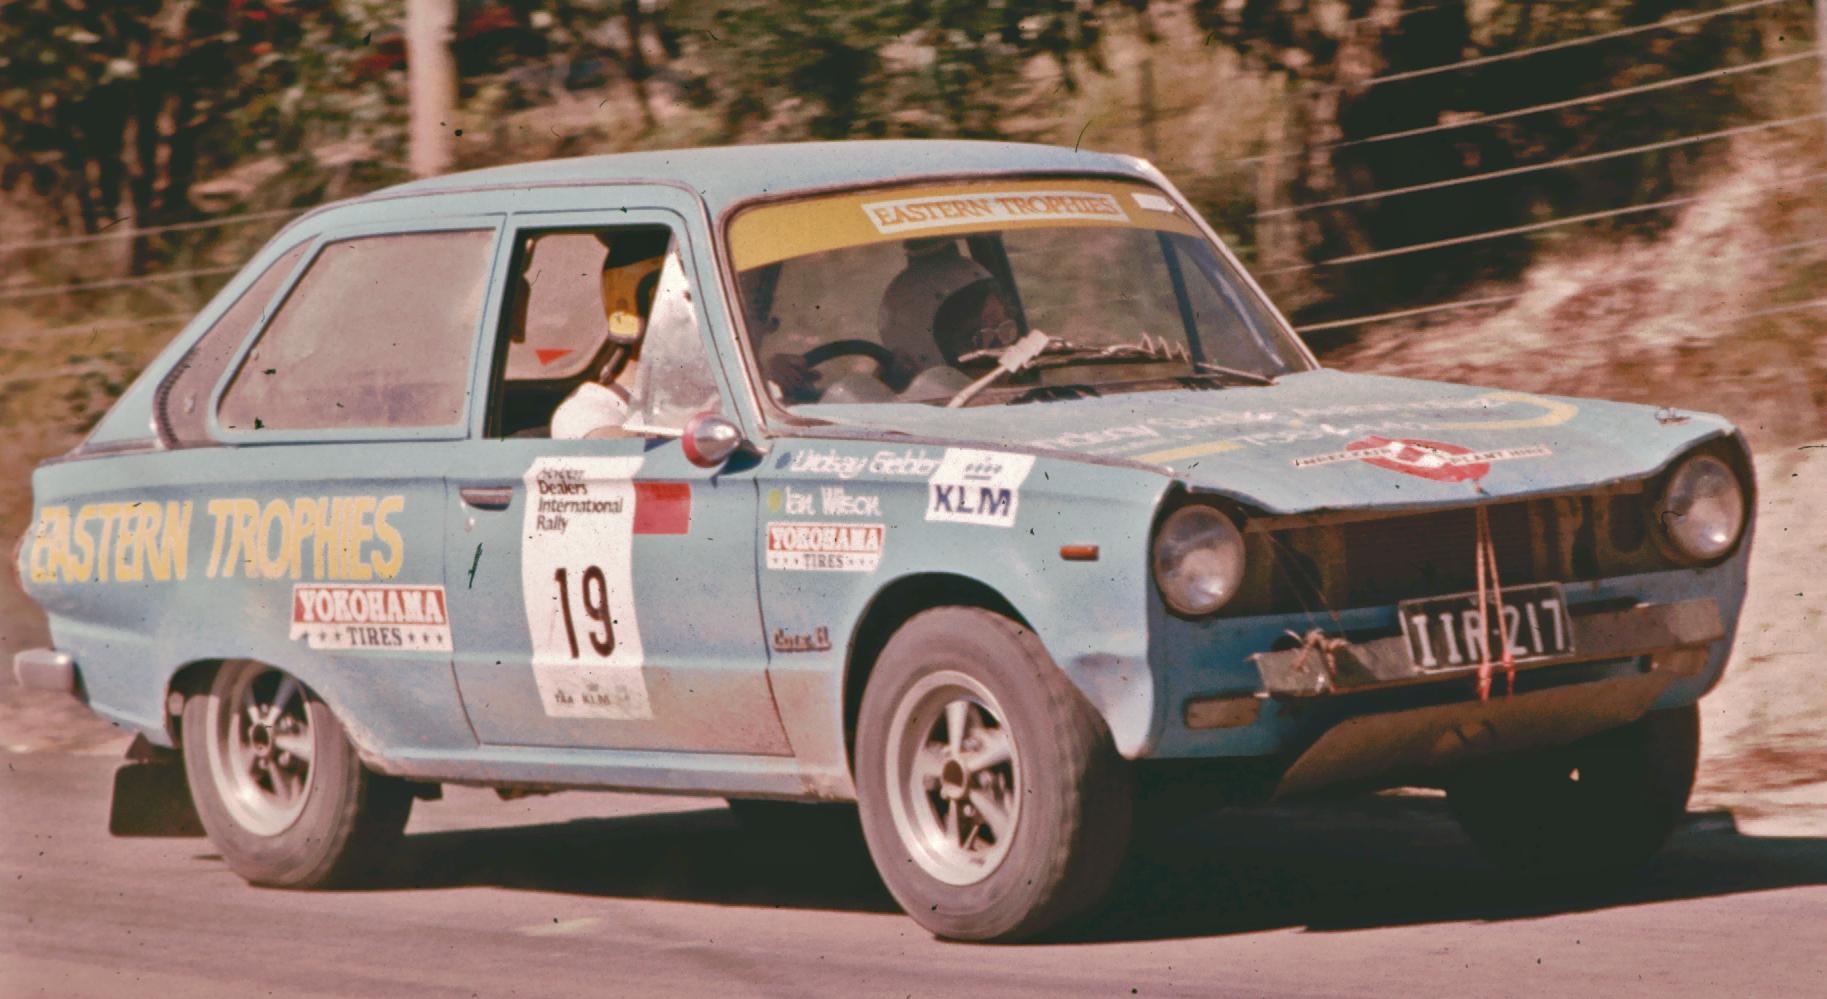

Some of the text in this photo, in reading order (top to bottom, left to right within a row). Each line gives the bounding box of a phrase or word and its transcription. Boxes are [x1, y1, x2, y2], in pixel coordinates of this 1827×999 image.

[871, 193, 1118, 226] EASTERN TROPHIES
[538, 479, 588, 495] Dealers
[538, 498, 623, 514] International
[934, 484, 1011, 517] KLM
[536, 515, 569, 534] Rally
[29, 495, 405, 583] EASTERN TROPHIES
[771, 526, 882, 551] YOKOHAMA
[803, 554, 844, 568] TIRES
[298, 588, 445, 623] YOKOHAMA
[555, 565, 616, 659] 19
[346, 627, 403, 646] TIRES
